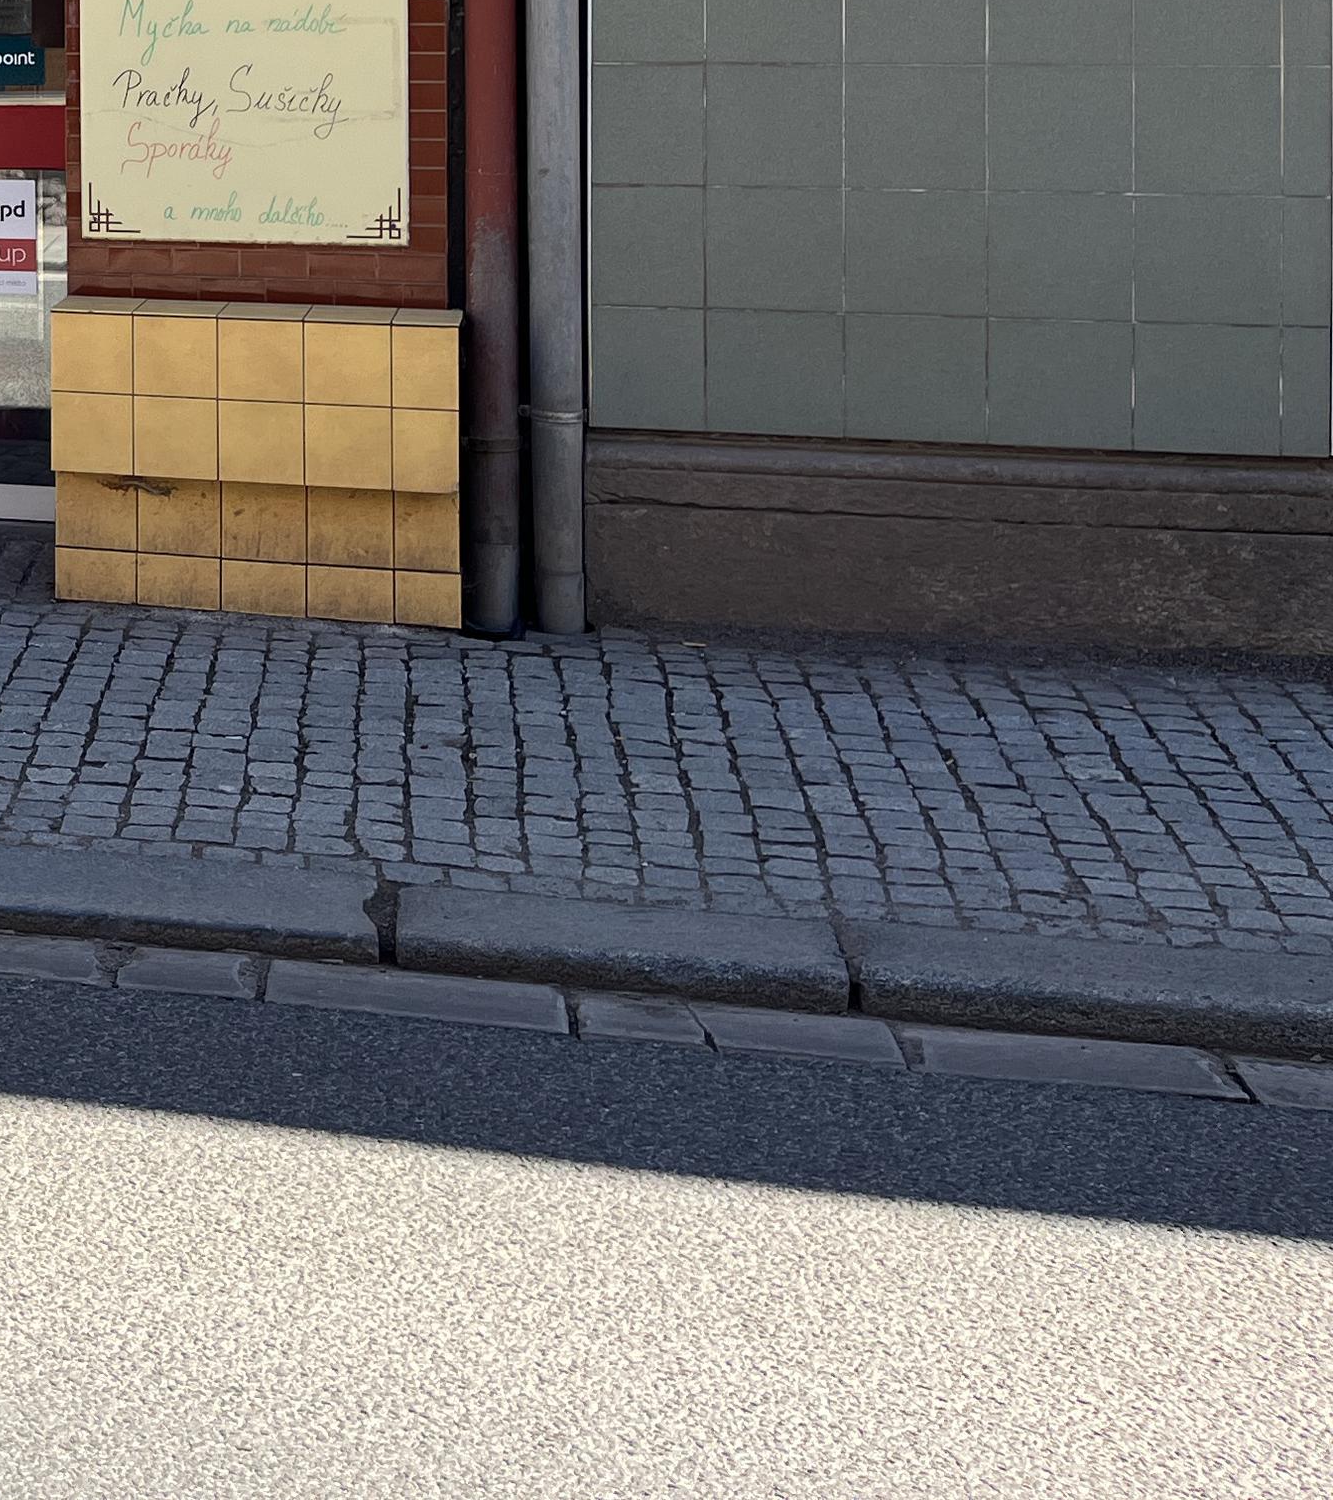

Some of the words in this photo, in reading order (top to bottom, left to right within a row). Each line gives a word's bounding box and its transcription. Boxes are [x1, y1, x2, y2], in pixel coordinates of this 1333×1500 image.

[226, 17, 255, 34] na
[226, 64, 350, 140] Sušičky
[121, 118, 233, 180] Sporáky
[164, 207, 178, 221] a
[190, 190, 241, 222] mnoho
